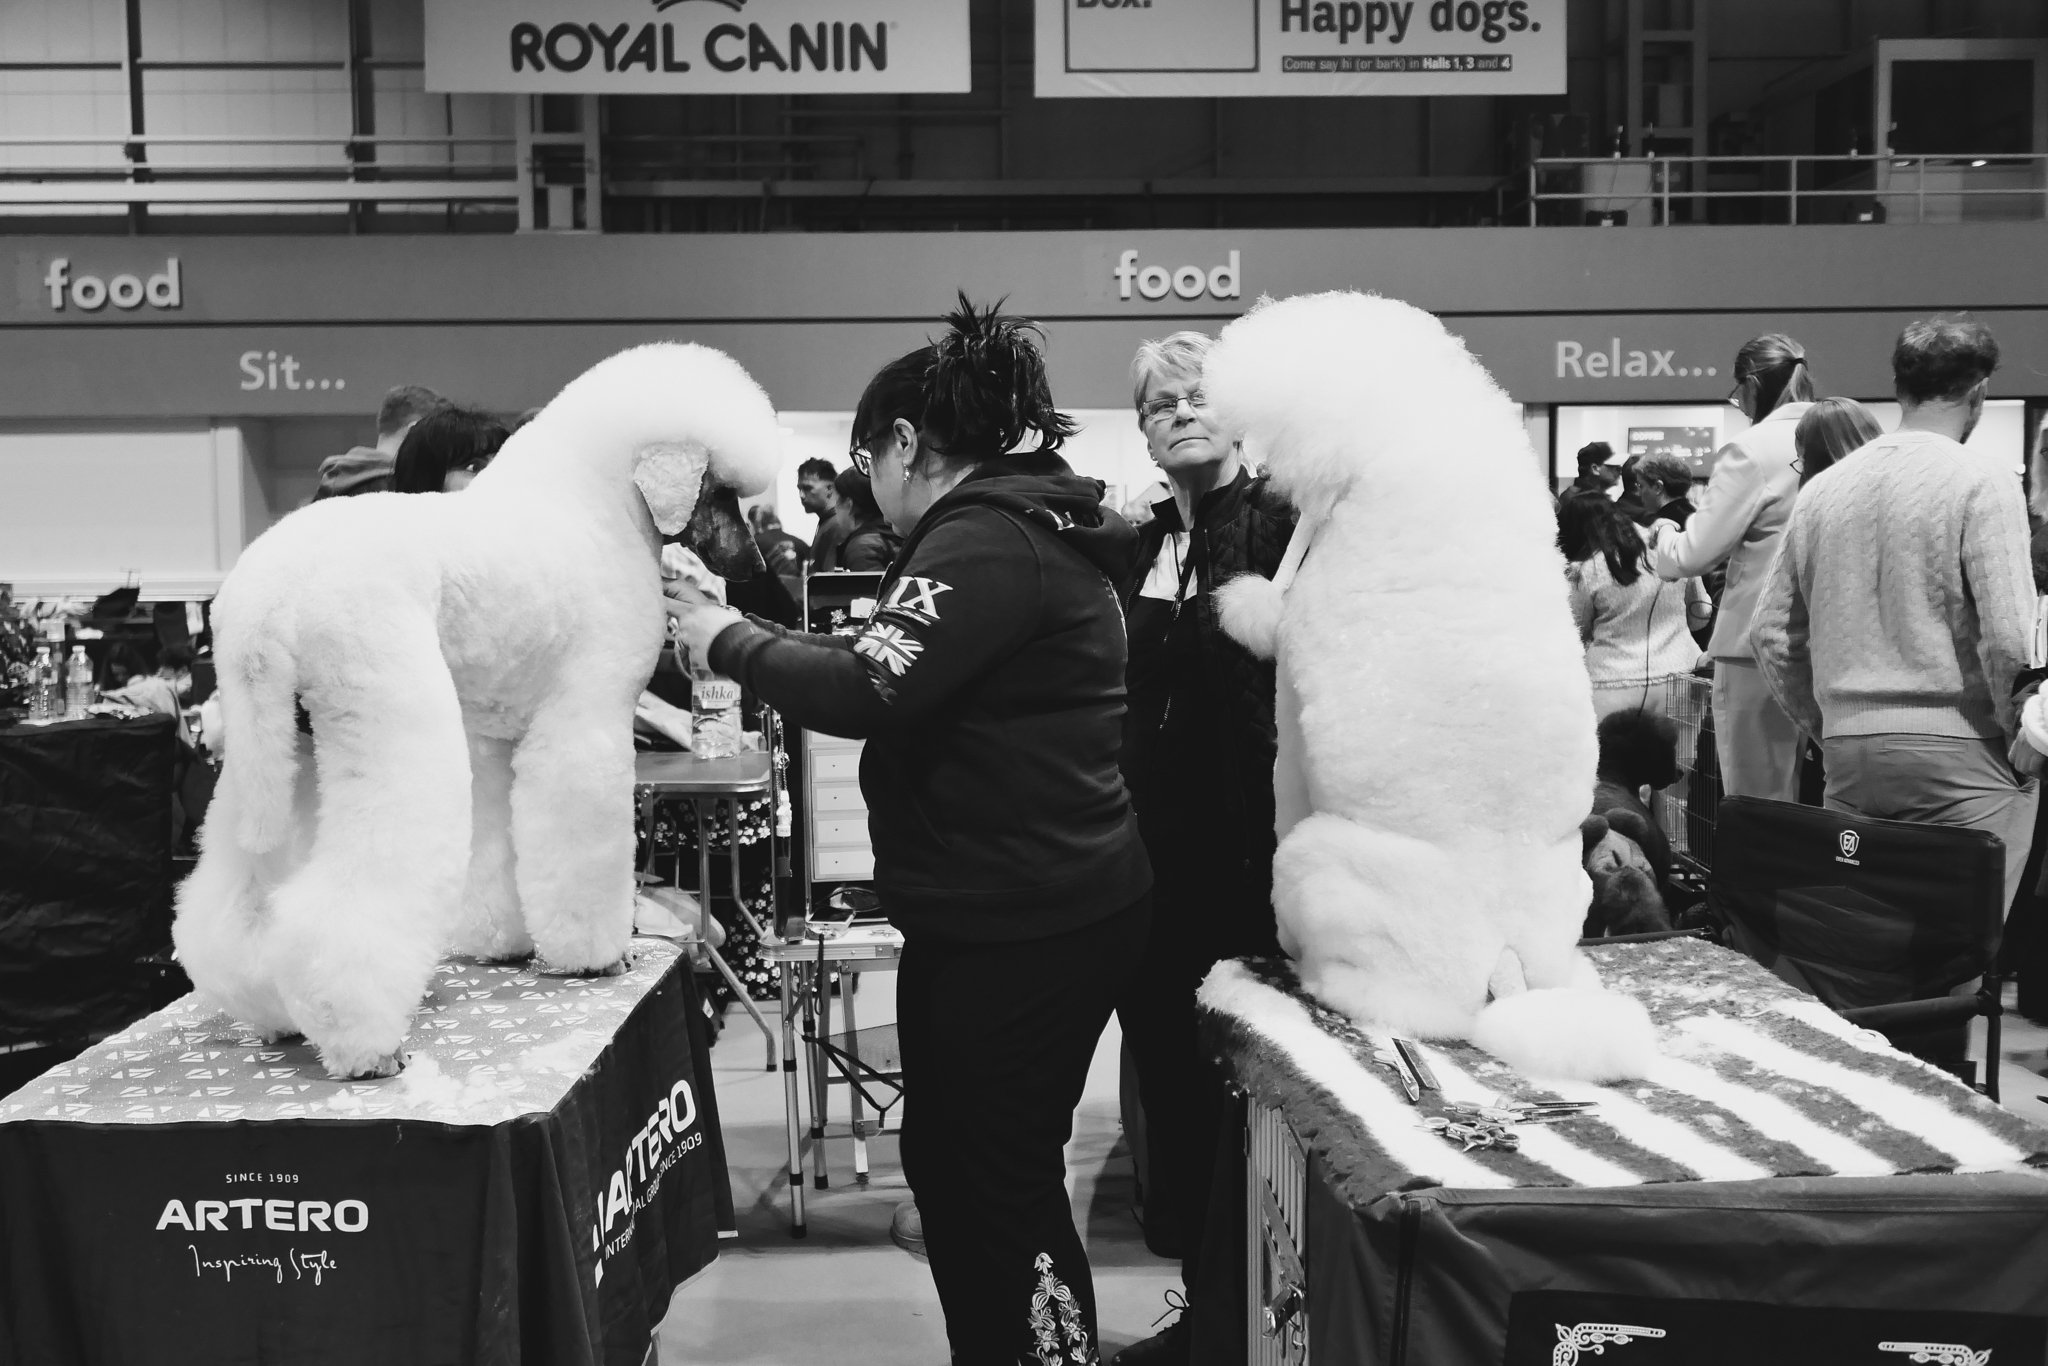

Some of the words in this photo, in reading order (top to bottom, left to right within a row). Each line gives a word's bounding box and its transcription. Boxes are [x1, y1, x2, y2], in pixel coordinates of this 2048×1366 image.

[1281, 0, 1415, 44] Happy
[1430, 0, 1541, 43] dogs.
[511, 21, 691, 73] ROYAL
[704, 21, 888, 72] CANIN
[1284, 58, 1317, 70] Come
[1319, 60, 1339, 73] say
[1342, 57, 1353, 70] hi
[1355, 57, 1373, 72] (or
[1375, 57, 1406, 72] bark)
[1409, 57, 1420, 69] in
[1422, 56, 1452, 69] Halls
[1454, 56, 1464, 70] 1,
[1466, 56, 1475, 69] 3
[1478, 57, 1498, 69] and
[1501, 57, 1511, 69] 4
[44, 257, 181, 310] food
[1114, 249, 1241, 299] food
[239, 350, 346, 391] Sit...
[1557, 337, 1717, 378] Relax...
[701, 685, 734, 700] ishka
[605, 1079, 696, 1233] ARTERO
[676, 1132, 703, 1159] 1909
[226, 1173, 263, 1183] SINCE
[269, 1173, 299, 1183] 1909
[155, 1198, 369, 1232] ARTERO
[188, 1244, 283, 1284] Inspiring
[290, 1248, 337, 1285] Style
